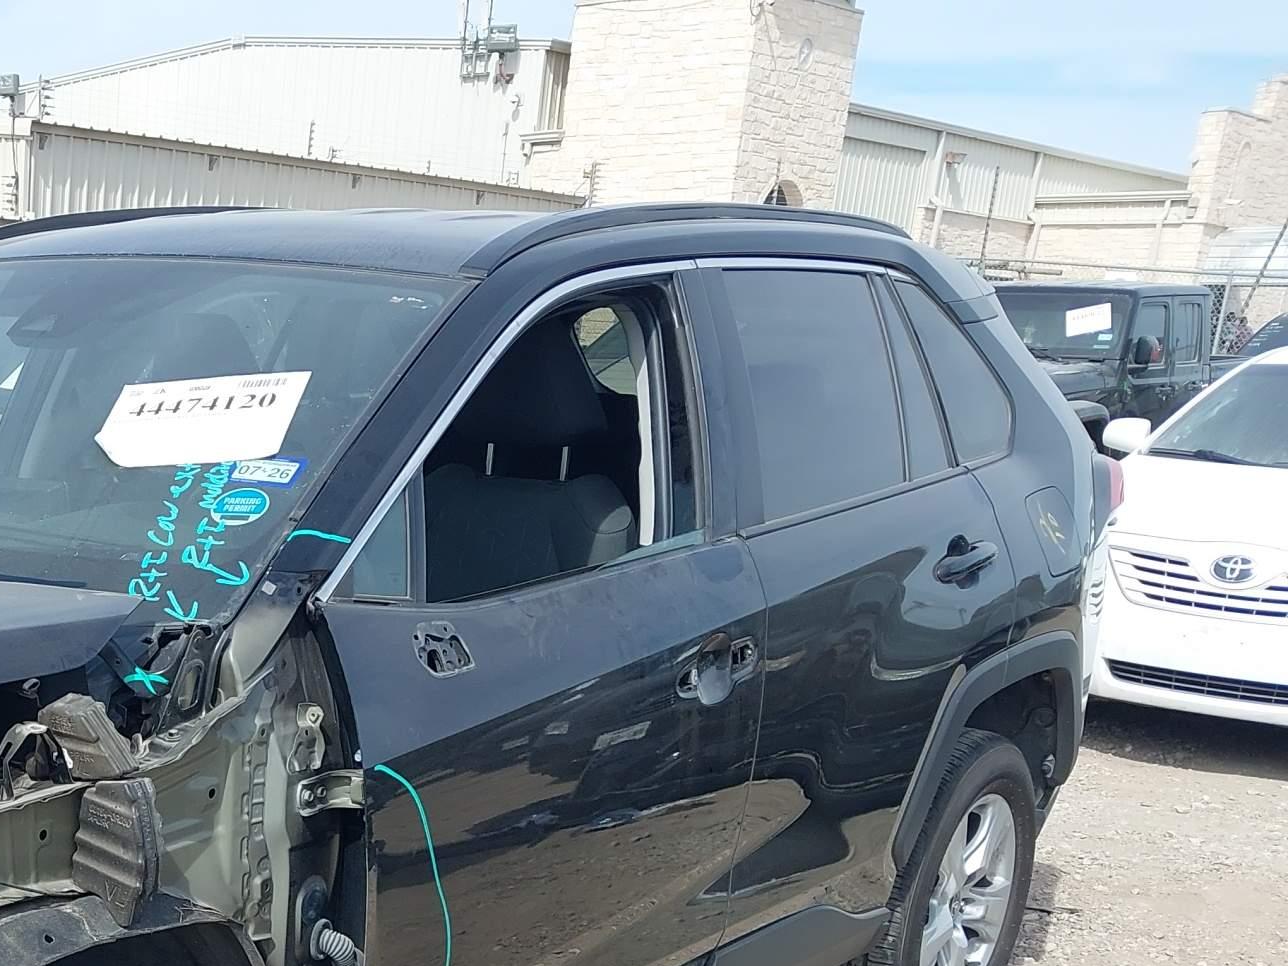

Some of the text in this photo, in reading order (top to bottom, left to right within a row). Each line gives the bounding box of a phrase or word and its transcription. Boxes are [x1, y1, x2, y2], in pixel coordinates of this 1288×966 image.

[128, 392, 277, 417] 44474120
[267, 467, 292, 479] 26
[223, 497, 262, 505] PARKING
[222, 504, 257, 513] PERMIT
